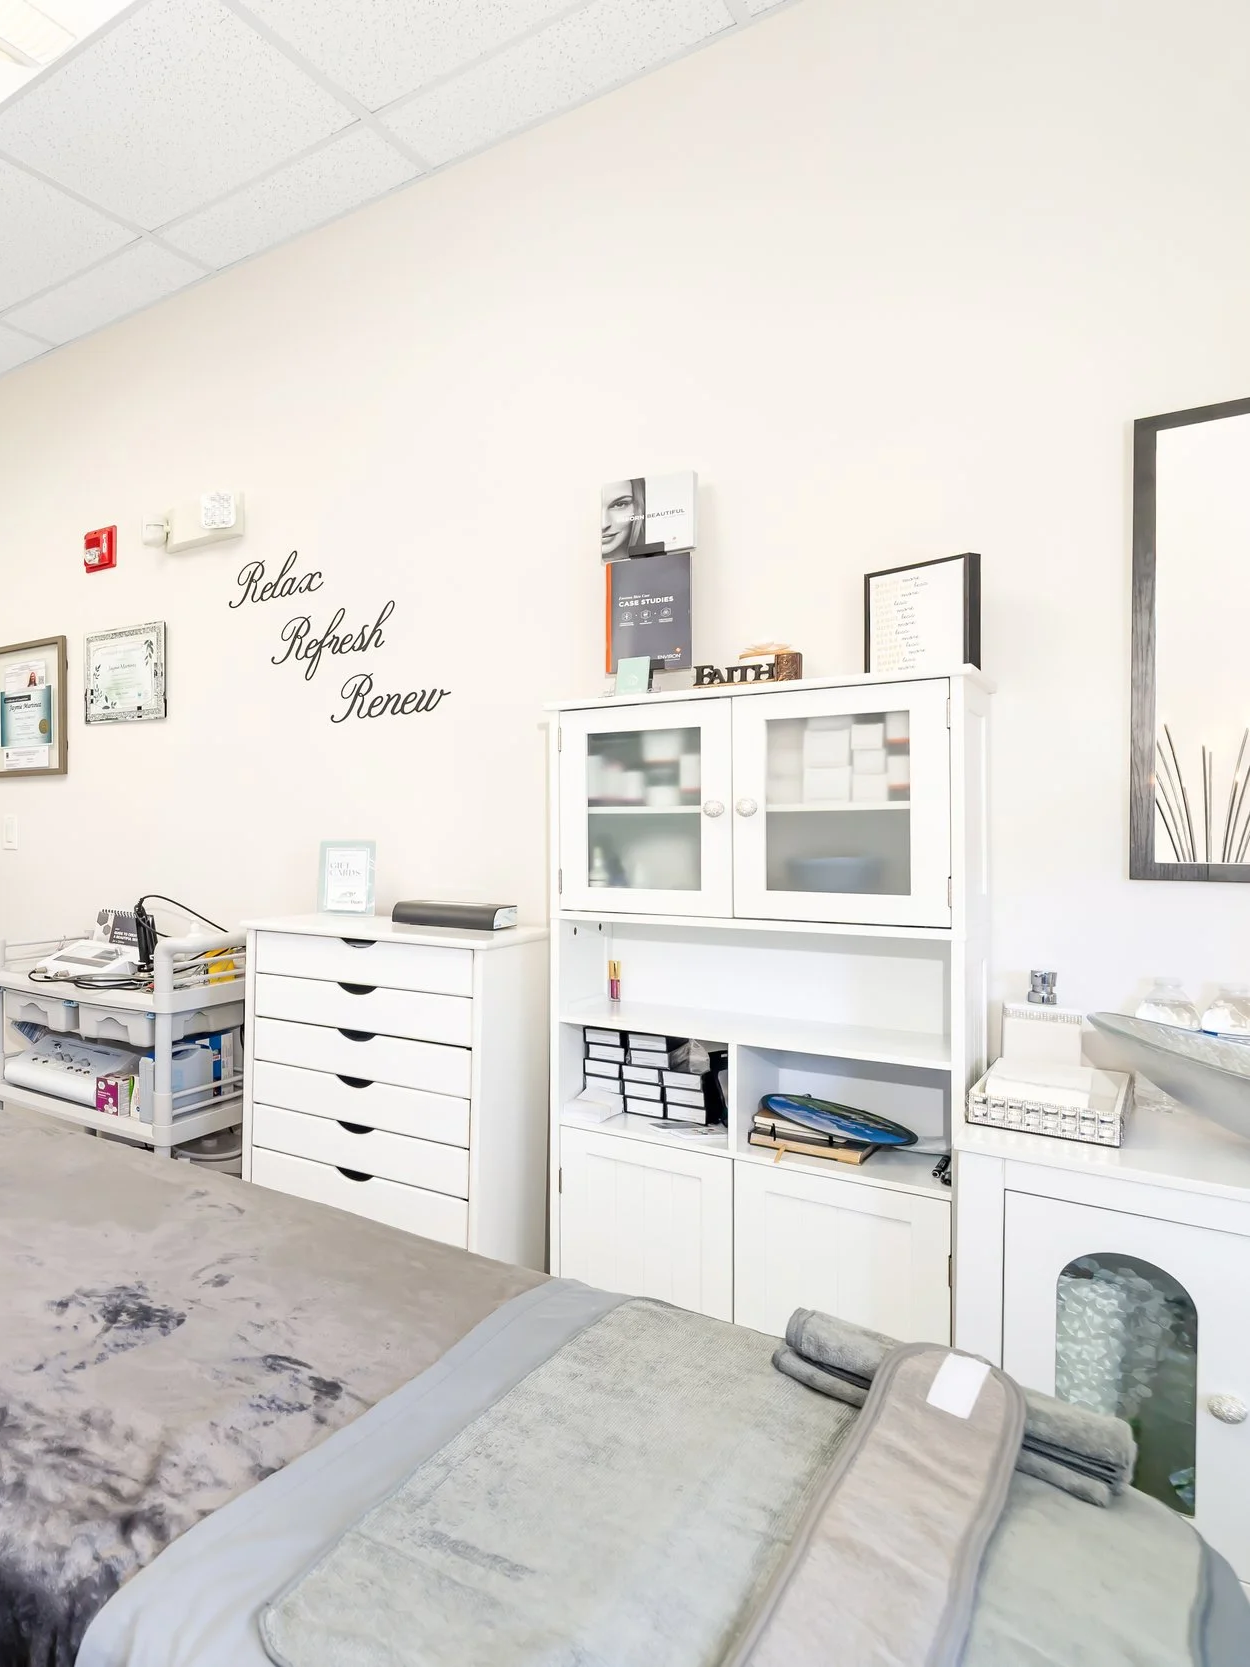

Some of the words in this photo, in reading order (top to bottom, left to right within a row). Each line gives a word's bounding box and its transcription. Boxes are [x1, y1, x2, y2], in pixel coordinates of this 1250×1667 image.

[647, 508, 686, 519] BEAUTIFUL
[228, 550, 324, 609] Relax
[618, 599, 640, 608] CASE
[640, 595, 675, 606] STUDIES
[271, 600, 396, 682] Refresh
[693, 663, 776, 687] FAITH
[330, 673, 452, 724] Renew
